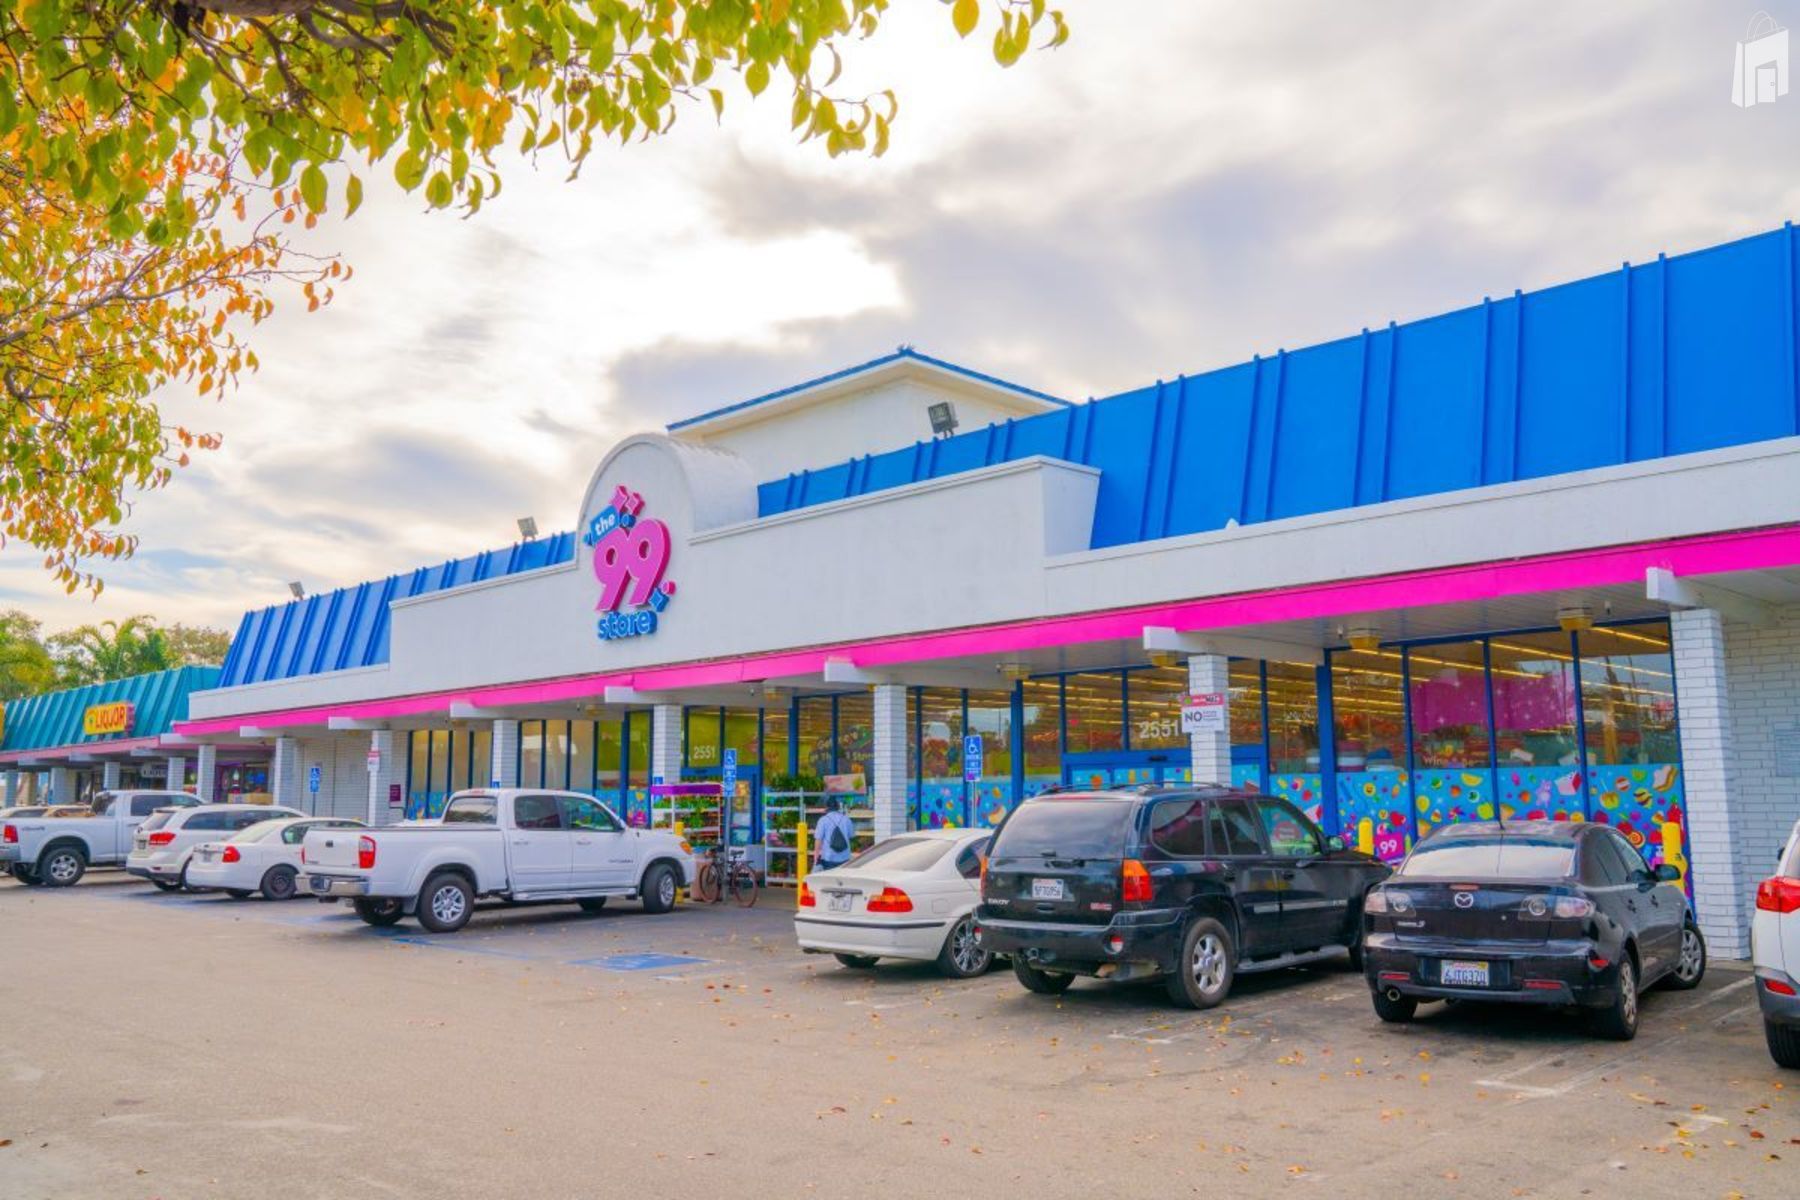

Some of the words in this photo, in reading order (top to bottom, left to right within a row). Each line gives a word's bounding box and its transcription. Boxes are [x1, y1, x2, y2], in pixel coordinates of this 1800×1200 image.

[595, 513, 616, 535] the
[594, 518, 669, 611] 99
[598, 611, 656, 640] store
[95, 705, 126, 729] LIQUOR
[1184, 710, 1203, 722] NO
[1139, 719, 1179, 738] 2551
[694, 744, 716, 759] 2551
[1380, 839, 1398, 855] 99
